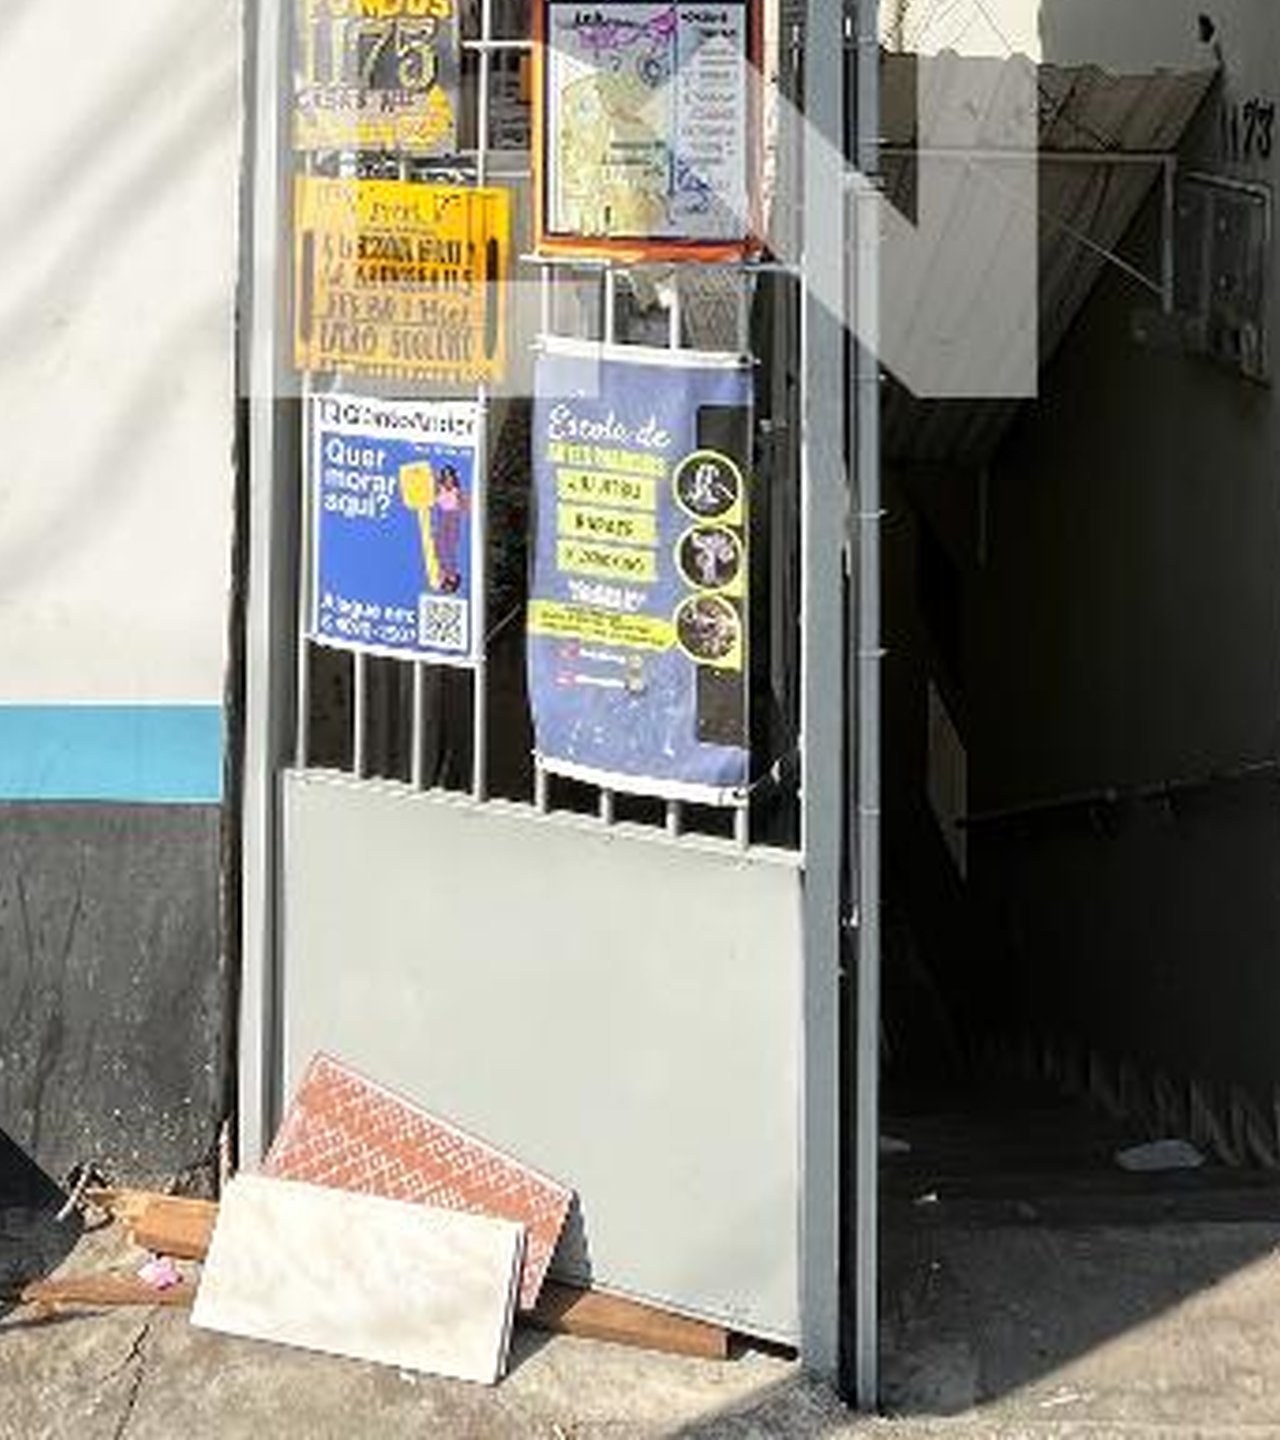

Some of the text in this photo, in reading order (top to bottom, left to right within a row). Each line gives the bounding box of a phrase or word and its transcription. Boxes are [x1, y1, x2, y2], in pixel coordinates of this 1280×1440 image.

[634, 413, 671, 448] de
[325, 437, 386, 471] Quer
[324, 467, 397, 497] morar
